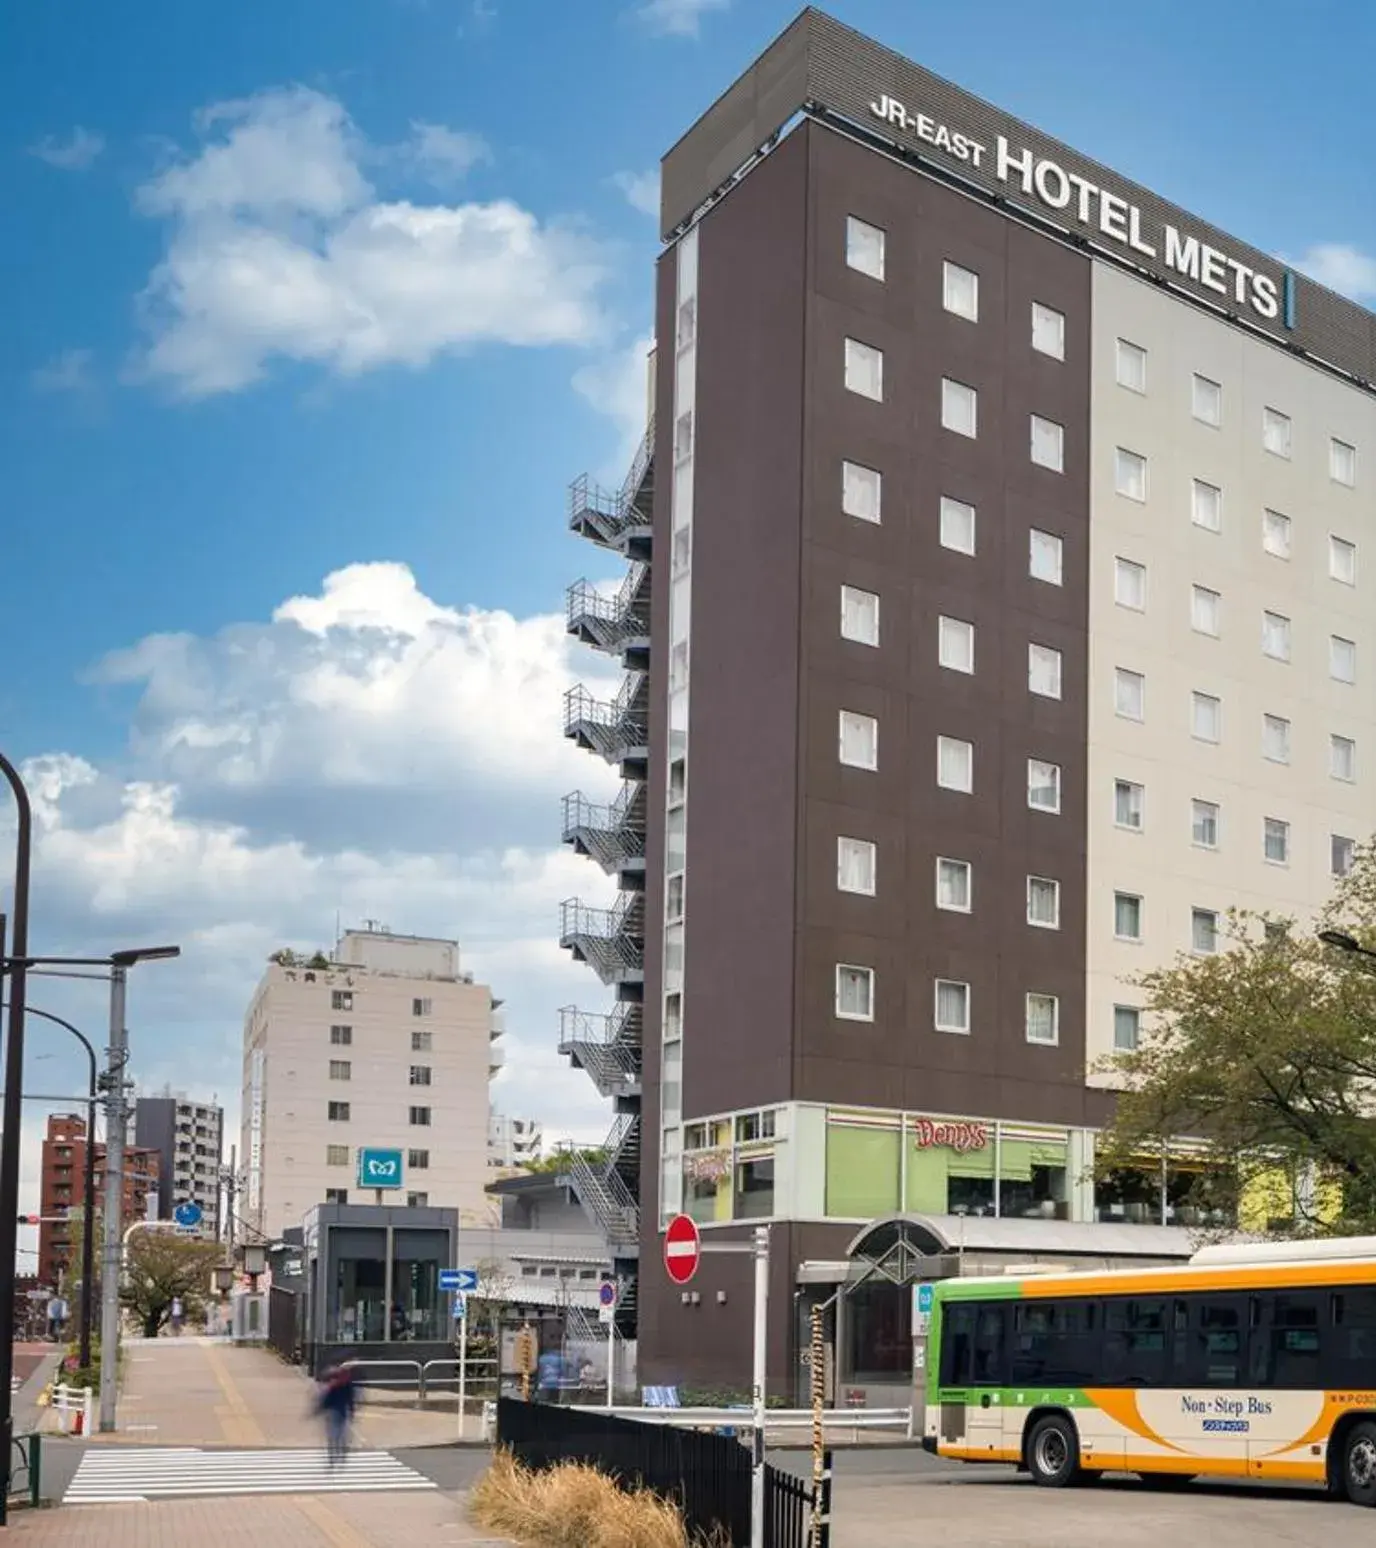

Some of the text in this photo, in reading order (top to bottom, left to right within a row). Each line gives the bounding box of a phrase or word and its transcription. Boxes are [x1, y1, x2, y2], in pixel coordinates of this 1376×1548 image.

[870, 94, 1279, 320] JR-EAST HOTEL METS
[914, 1117, 987, 1154] Denny's
[1247, 1396, 1273, 1415] Bus
